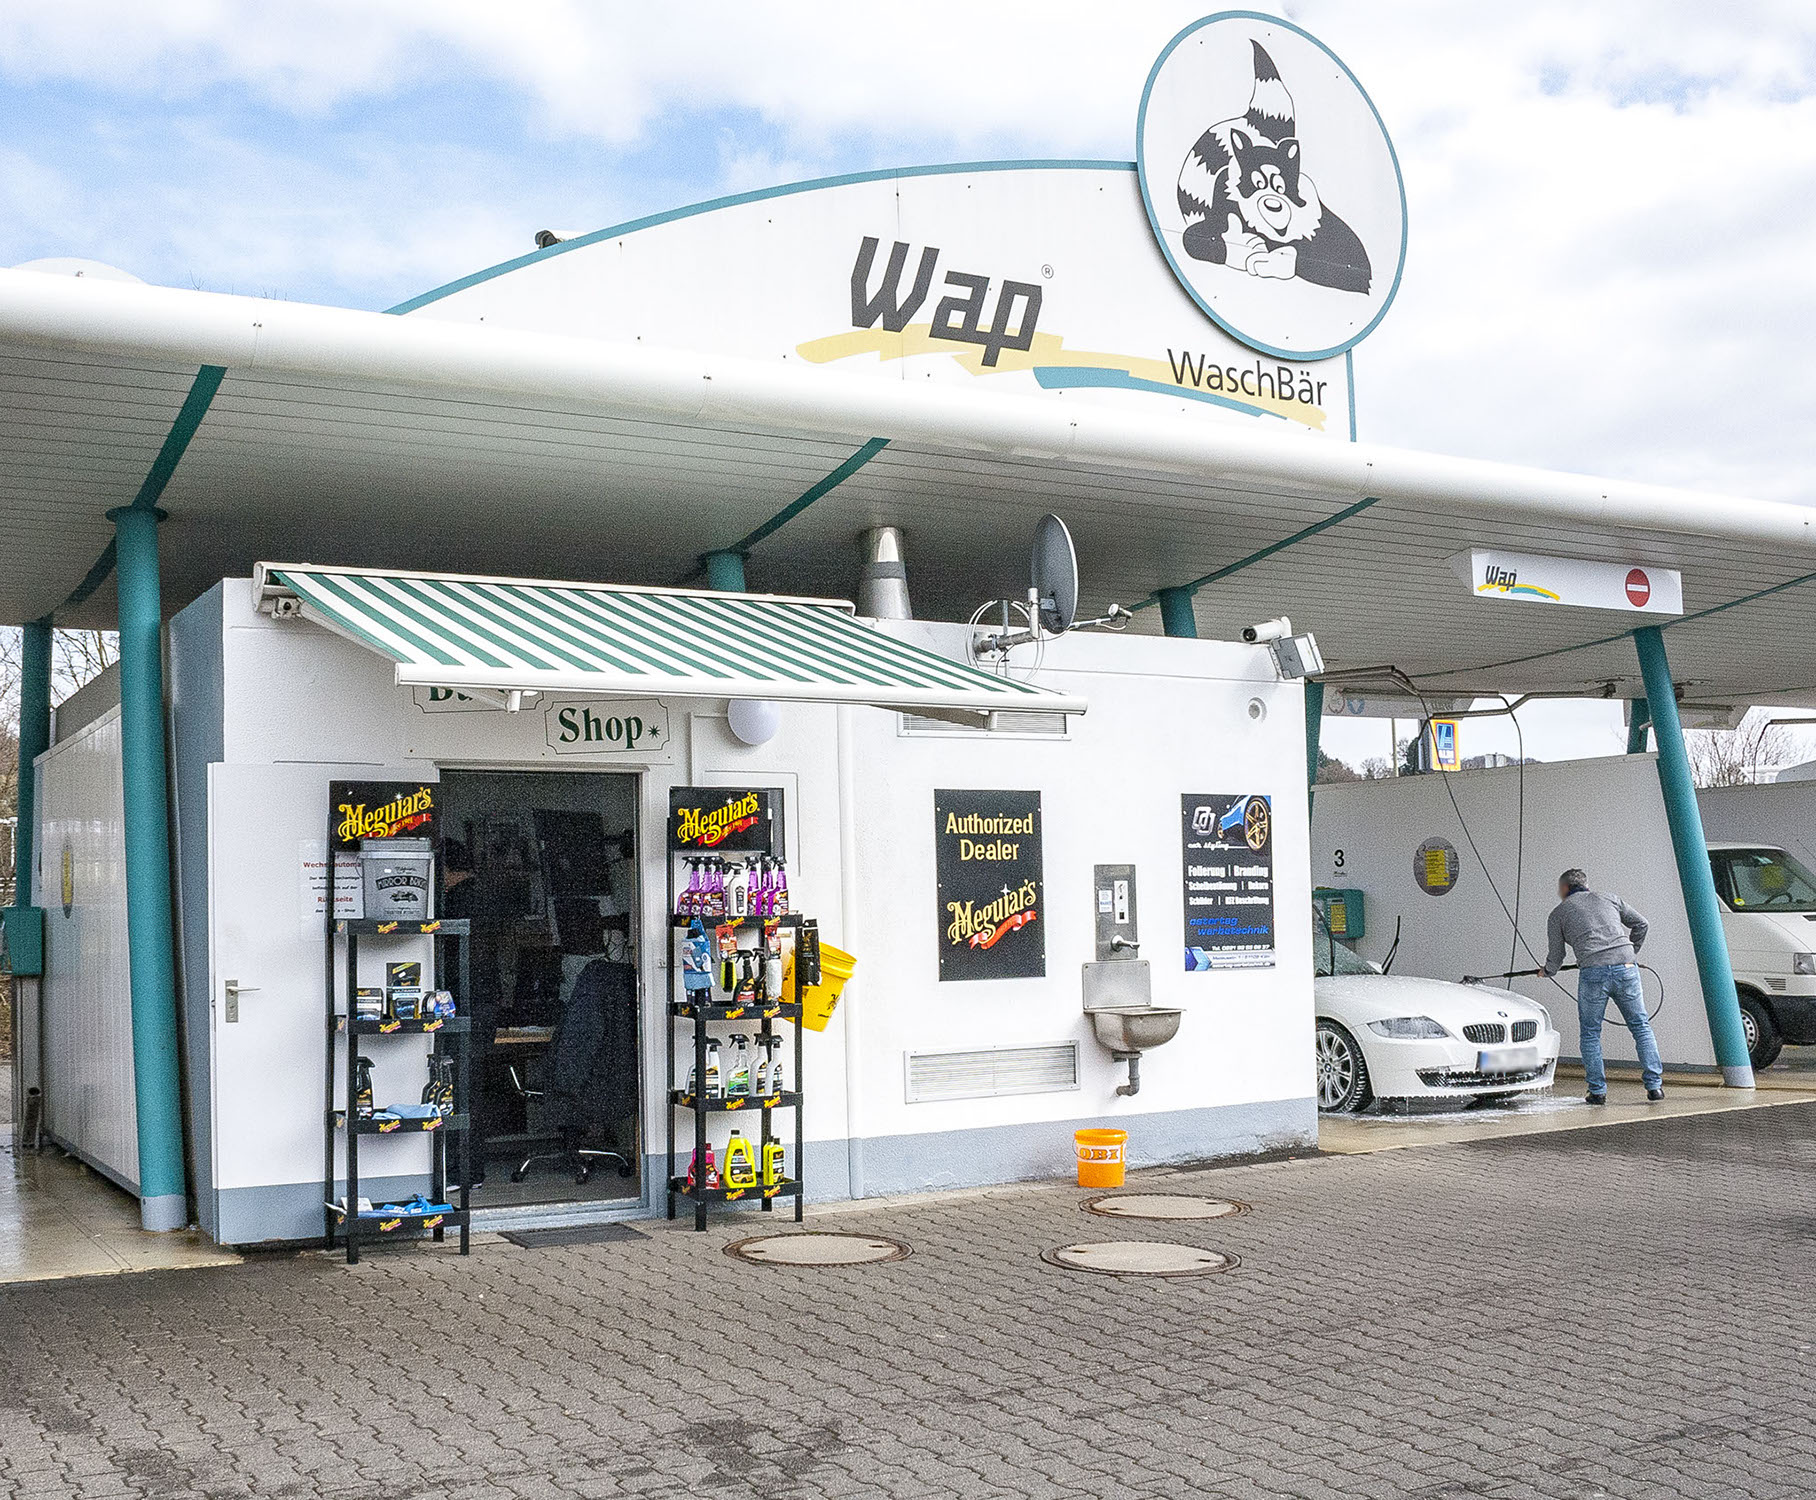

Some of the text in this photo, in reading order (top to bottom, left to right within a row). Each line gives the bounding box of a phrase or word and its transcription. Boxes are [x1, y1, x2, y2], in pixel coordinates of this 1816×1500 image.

[851, 236, 1042, 367] Wap
[1166, 348, 1327, 407] WaschBär
[1485, 565, 1517, 591] Wap
[558, 707, 643, 749] Shop
[338, 787, 433, 842] Meguiar's
[677, 791, 760, 844] Meguiar's
[945, 812, 1034, 835] Authorized
[960, 839, 1020, 861] Dealer
[1334, 849, 1345, 868] 3
[1188, 865, 1269, 878] Folierung Branding
[947, 878, 1036, 944] Meguiar's
[1189, 896, 1214, 905] Schilder
[1080, 1148, 1119, 1160] OBI
